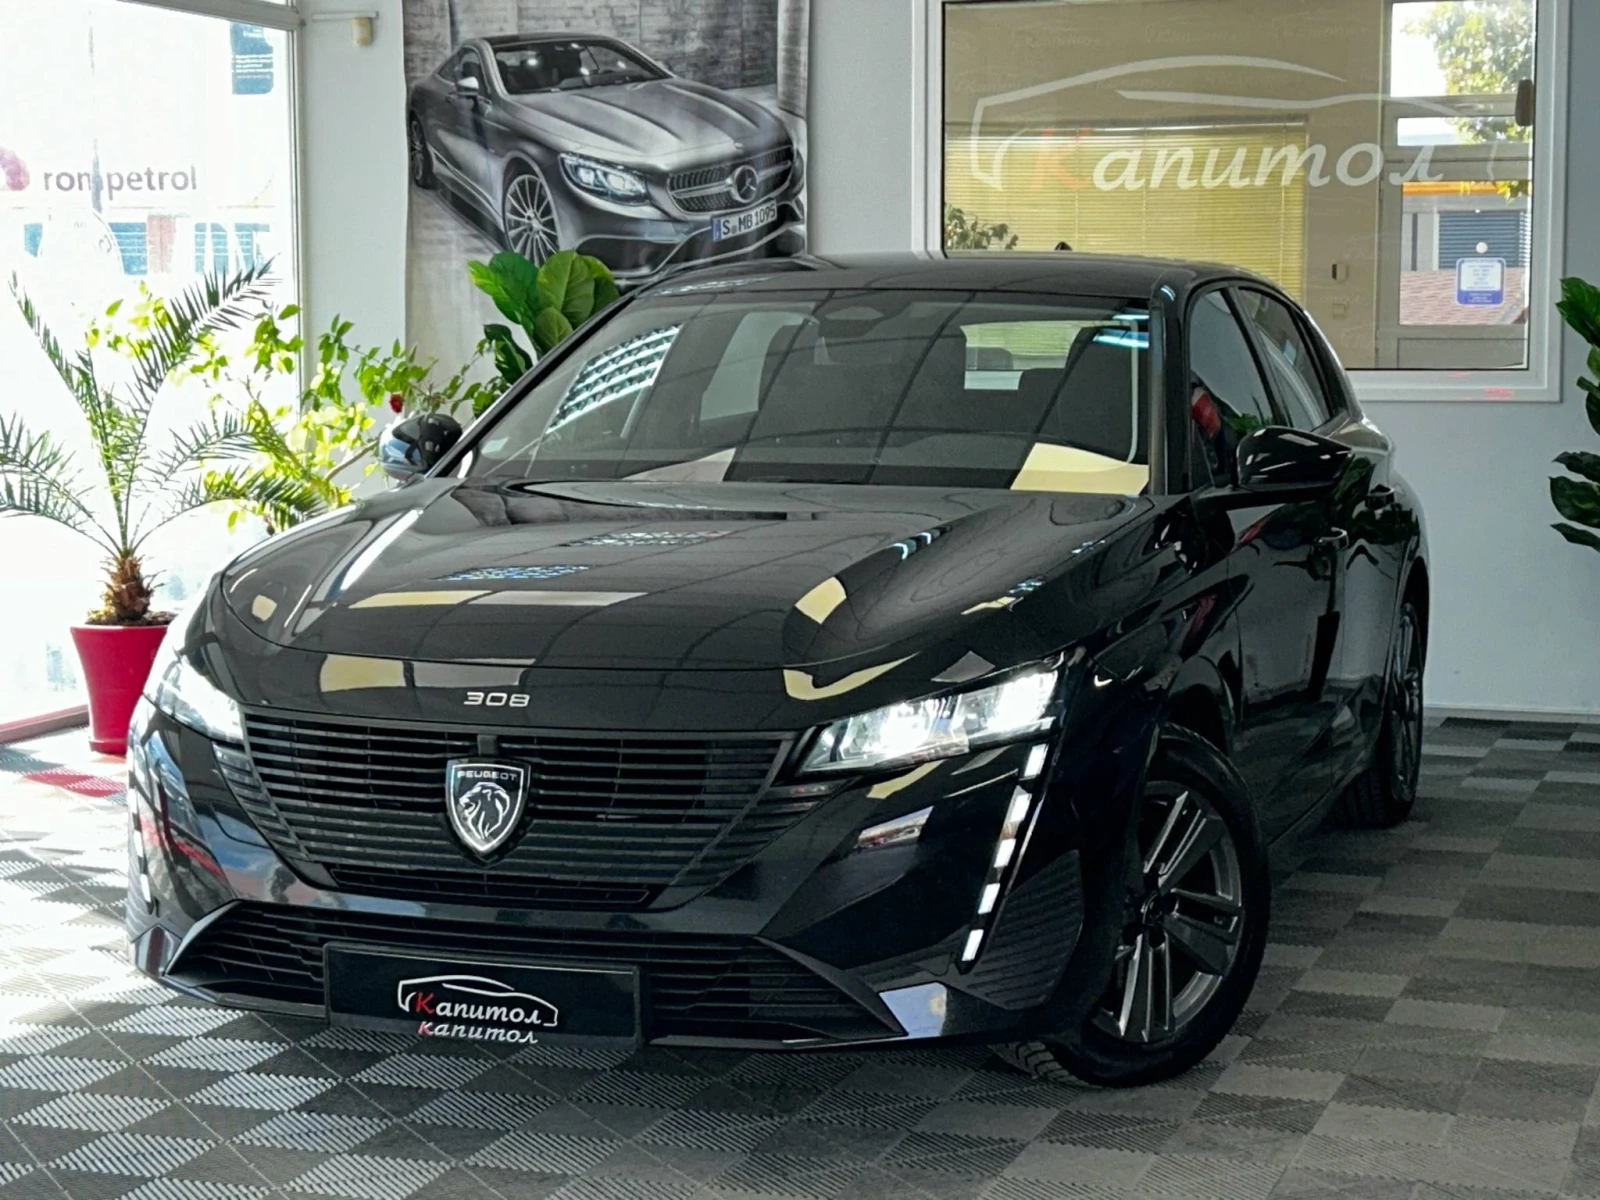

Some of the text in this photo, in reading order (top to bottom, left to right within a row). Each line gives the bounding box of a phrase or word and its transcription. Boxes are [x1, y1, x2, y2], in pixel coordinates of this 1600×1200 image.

[1030, 128, 1444, 192] Капитол
[44, 164, 197, 201] rompetrol
[722, 219, 730, 235] S
[738, 213, 753, 232] MB
[463, 691, 531, 708] 308
[456, 770, 518, 781] PEUGEOT
[415, 991, 542, 1025] Капитол
